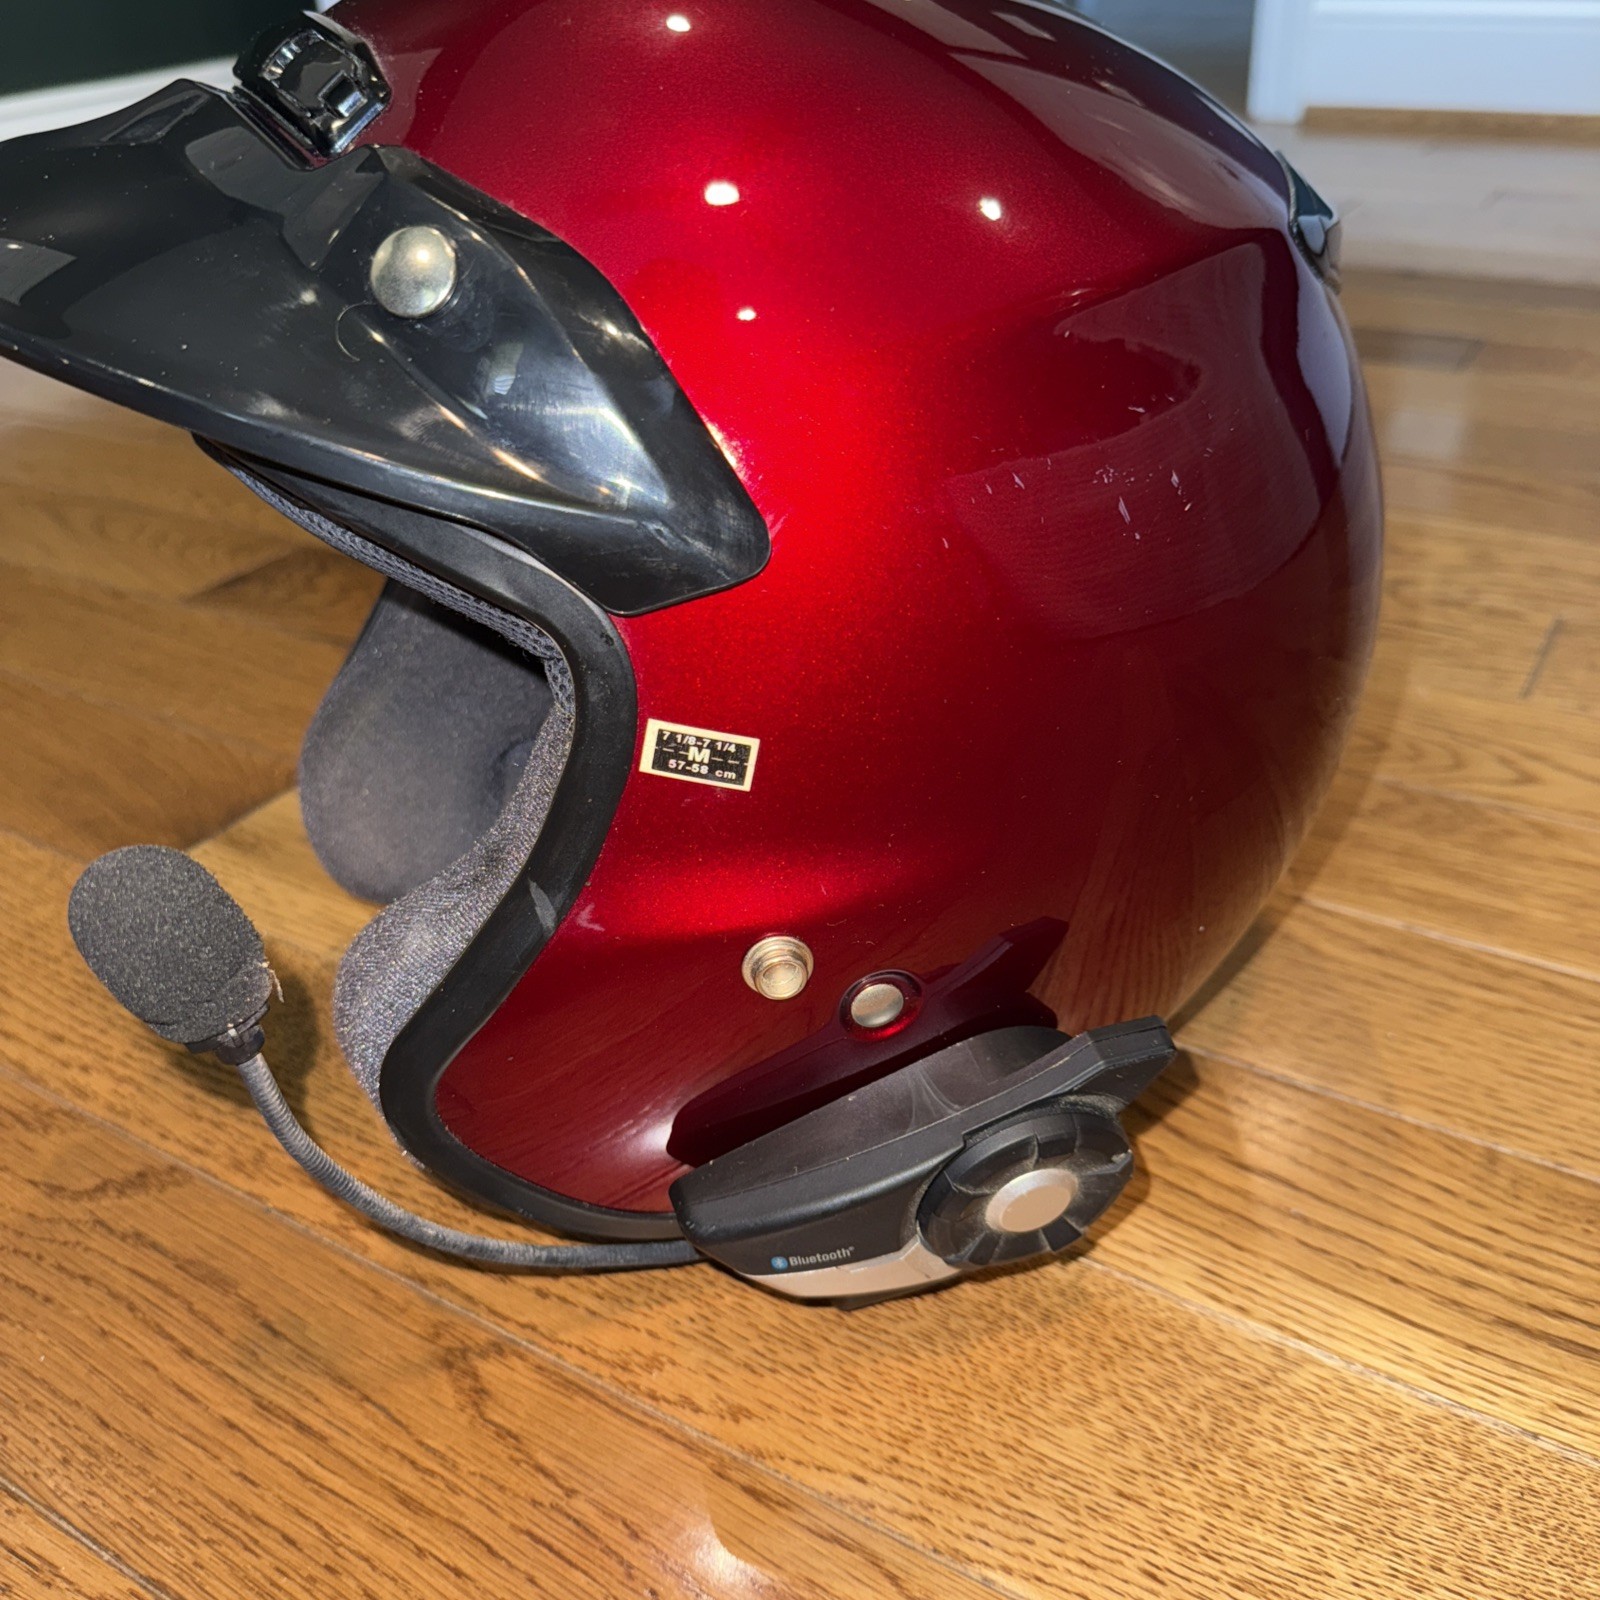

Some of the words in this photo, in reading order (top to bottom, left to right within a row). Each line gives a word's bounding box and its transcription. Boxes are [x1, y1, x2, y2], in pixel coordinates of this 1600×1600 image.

[662, 731, 671, 741] 7
[716, 741, 736, 753] 1/4
[687, 746, 711, 764] M
[668, 759, 709, 775] 57-58
[715, 770, 737, 780] cm
